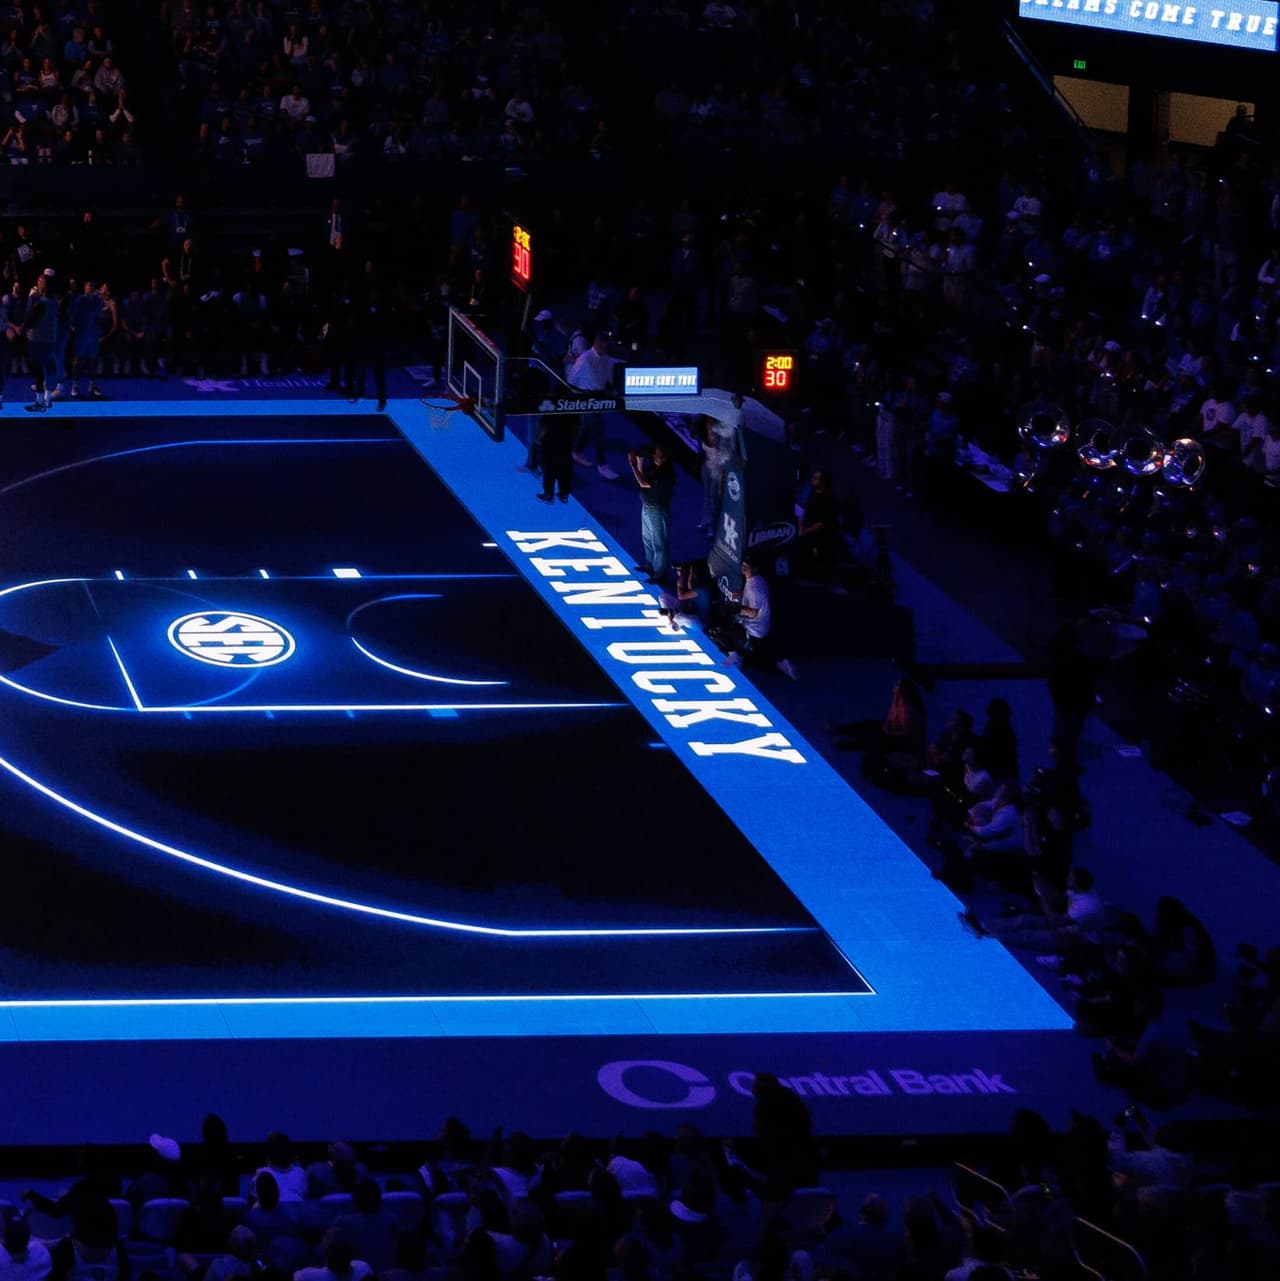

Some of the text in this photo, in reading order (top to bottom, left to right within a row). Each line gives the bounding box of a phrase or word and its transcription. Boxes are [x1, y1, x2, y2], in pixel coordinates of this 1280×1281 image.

[1129, 0, 1197, 25] COME
[1210, 9, 1278, 35] TRUE
[766, 356, 793, 369] 2:00
[766, 370, 787, 387] 30
[178, 616, 285, 662] SEC
[505, 529, 808, 765] KENTUCKY
[889, 1068, 1017, 1095] Bank
